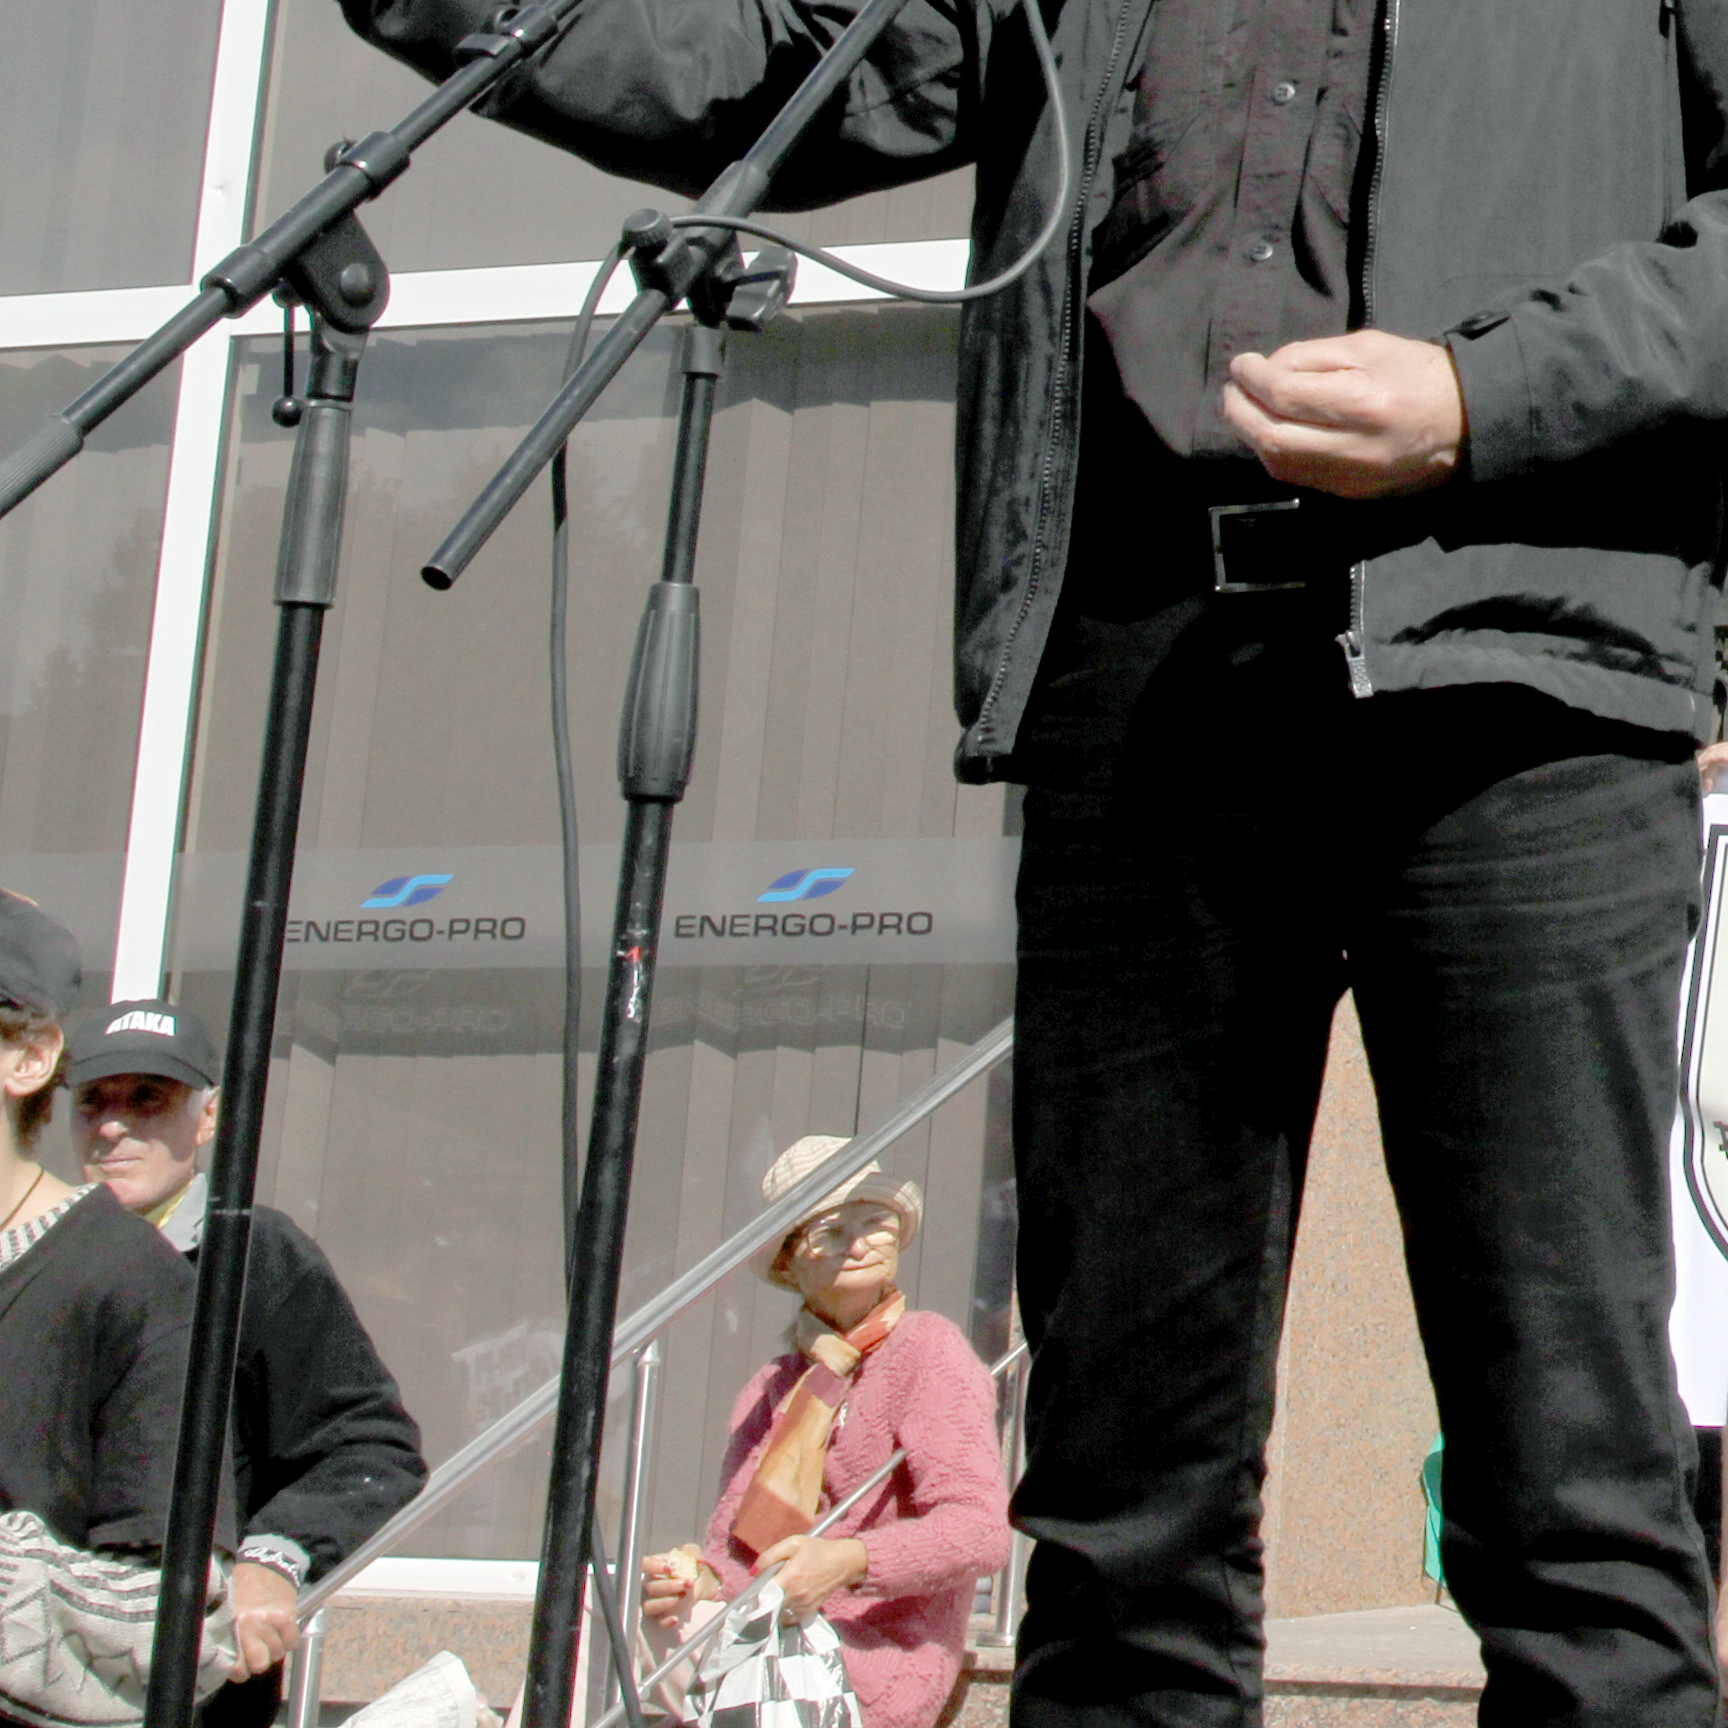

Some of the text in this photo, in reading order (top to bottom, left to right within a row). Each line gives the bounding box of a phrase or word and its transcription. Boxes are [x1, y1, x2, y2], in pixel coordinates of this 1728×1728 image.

[283, 917, 527, 943] ENERGO-PRO
[674, 911, 933, 939] ENERGO-PRO
[105, 1010, 175, 1037] АТАКА
